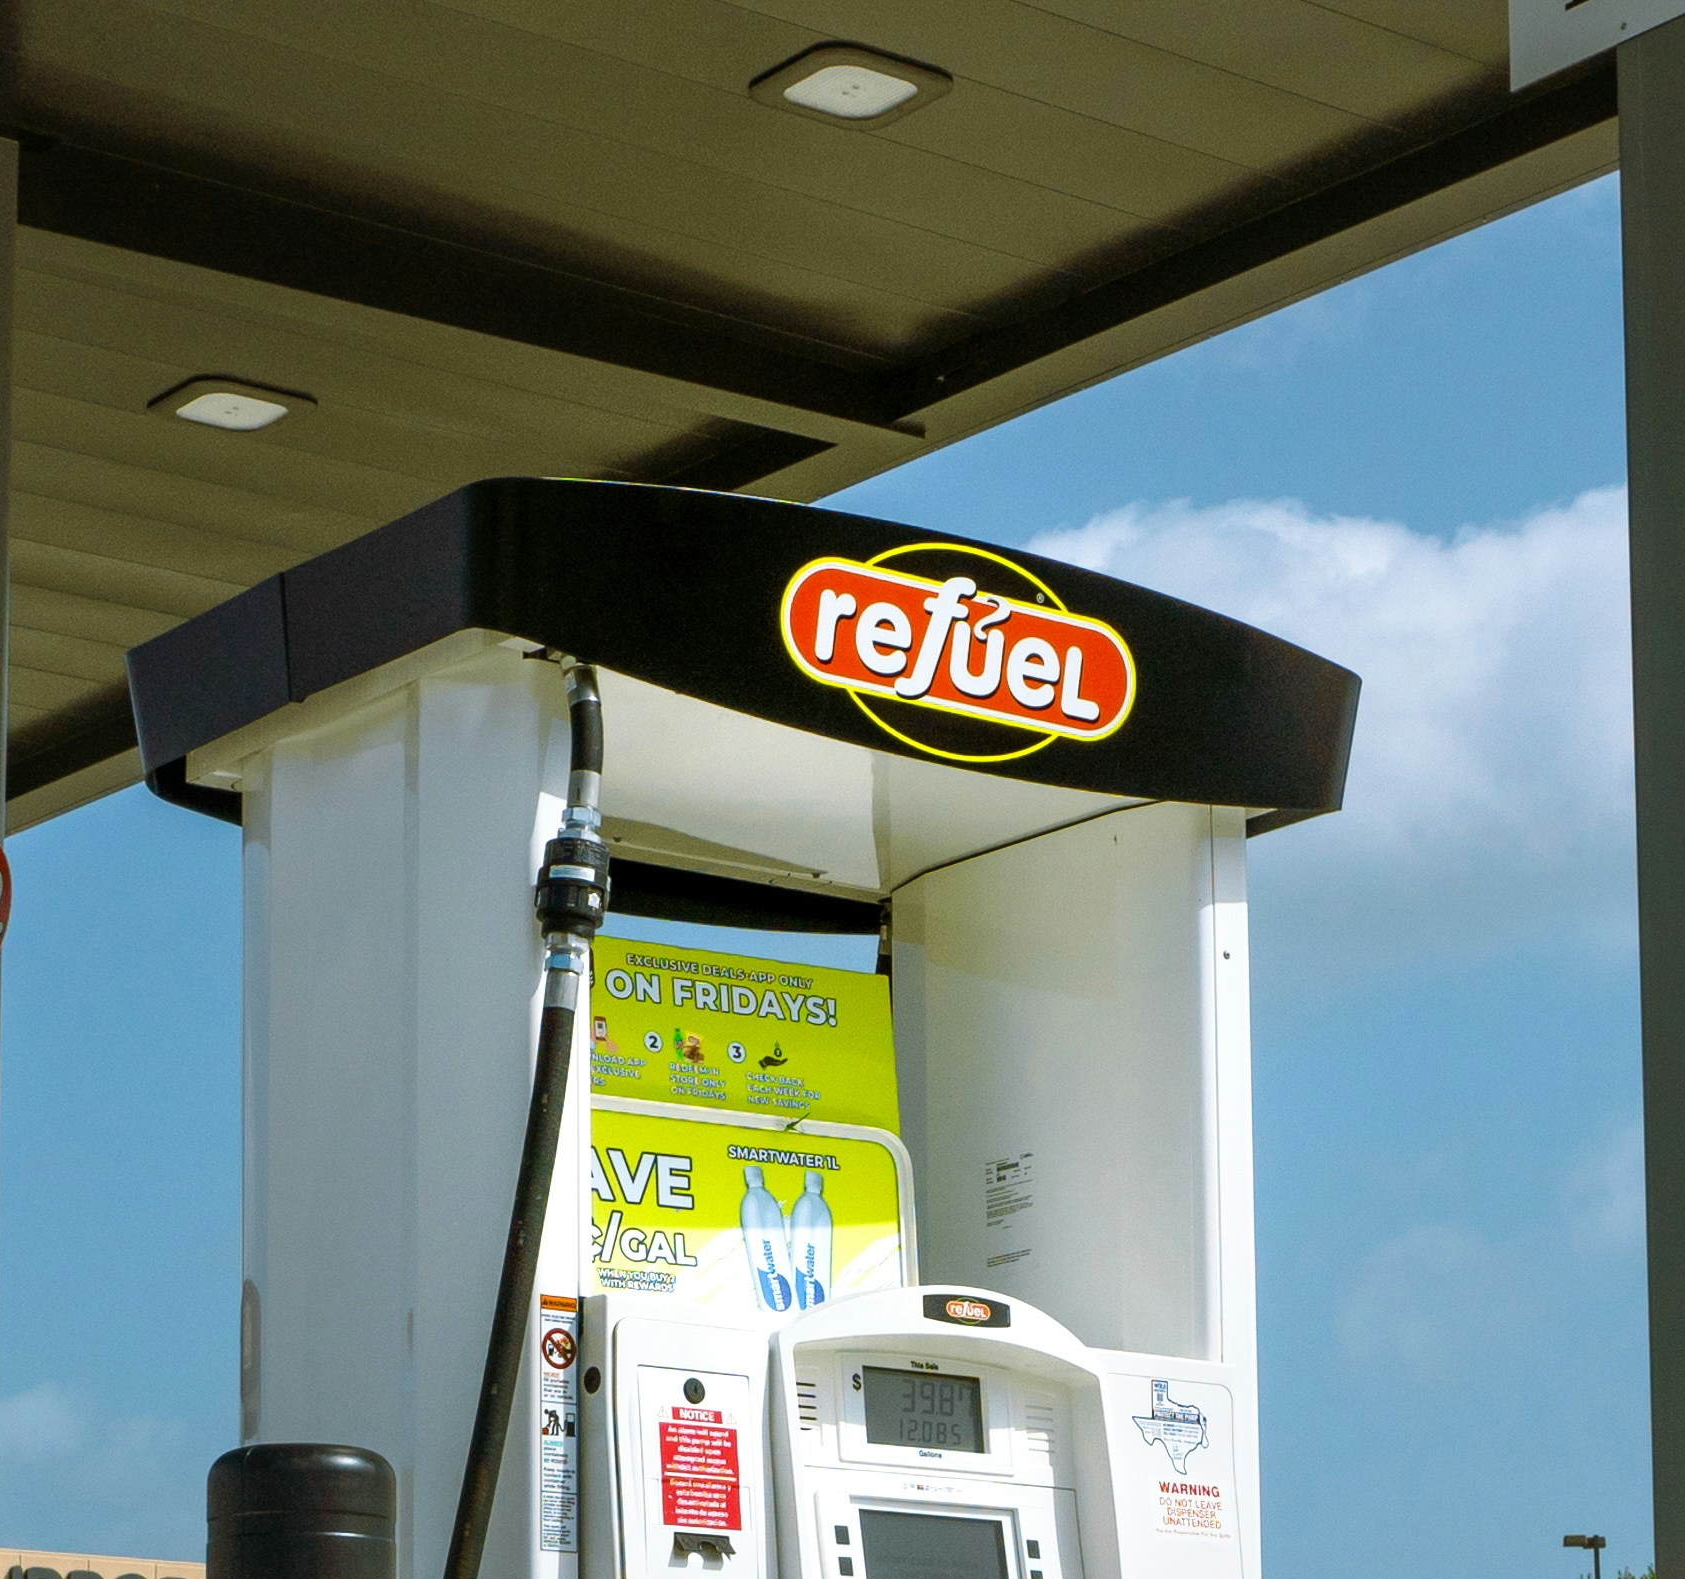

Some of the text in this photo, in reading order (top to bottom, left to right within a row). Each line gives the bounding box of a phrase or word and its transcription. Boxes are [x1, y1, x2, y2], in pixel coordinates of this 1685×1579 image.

[626, 953, 698, 974] EXCLUSIVE
[779, 975, 813, 990] ONLY
[605, 969, 838, 1028] ON FRIDAYS!
[669, 1062, 708, 1075] REDEEM
[670, 1074, 726, 1088] STORE ONLY
[746, 1071, 804, 1088] CHECK BACK
[671, 1086, 726, 1100] ON FRIDAYS
[747, 1083, 820, 1100] EACH WEEK FOR
[748, 1095, 810, 1110] NEW SAVINGS
[728, 1144, 823, 1168] SMARTWATER
[597, 1267, 627, 1280] WHEN
[628, 1271, 648, 1281] YOU
[649, 1272, 668, 1283] BUY
[601, 1279, 674, 1293] WITH REWARDS
[910, 1360, 939, 1371] This Sale
[852, 1372, 862, 1392] $
[679, 1408, 715, 1421] NOTICE
[918, 1450, 942, 1459] Gallons
[1159, 1481, 1220, 1498] WARNING
[1159, 1497, 1223, 1511] DO NOT LEAVE
[1167, 1507, 1216, 1519] DISPENSER
[1163, 1516, 1222, 1529] UNATTENDED
